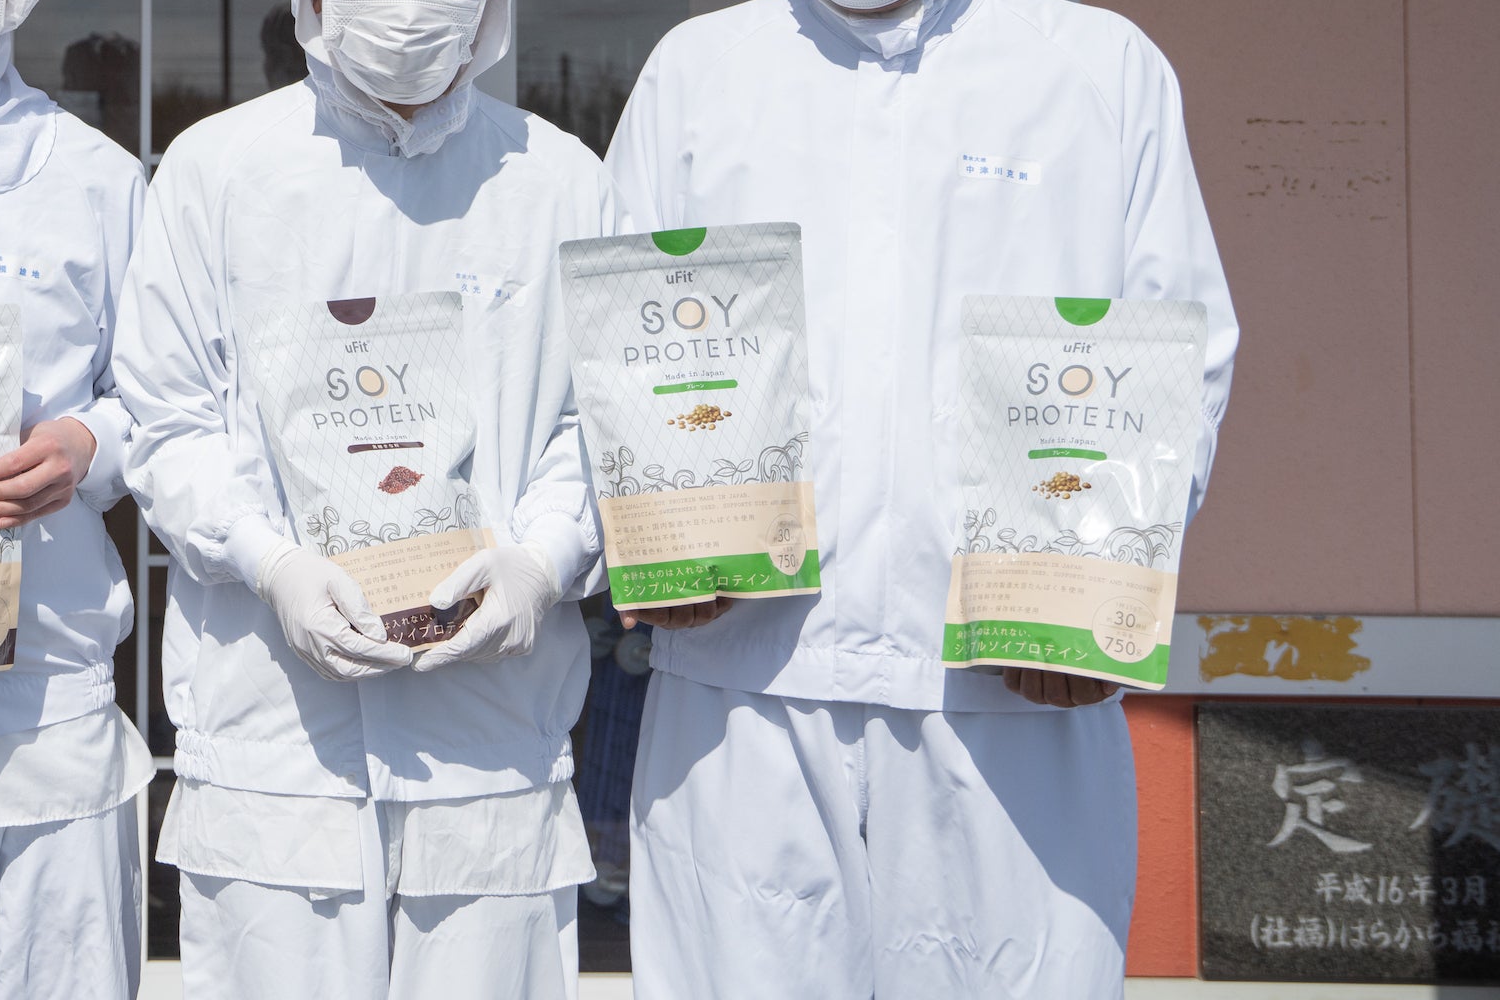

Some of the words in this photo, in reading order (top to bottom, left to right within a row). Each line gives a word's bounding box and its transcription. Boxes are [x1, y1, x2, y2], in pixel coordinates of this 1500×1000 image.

[666, 271, 693, 284] uFit
[641, 294, 739, 334] SOY
[345, 341, 368, 354] uFit
[623, 336, 761, 367] PROTEIN
[1063, 342, 1092, 354] uFit
[326, 363, 409, 401] SOY
[665, 373, 686, 381] Made
[701, 370, 725, 379] Japan
[1026, 363, 1133, 398] SOY
[312, 402, 437, 430] PROTEIN
[1008, 405, 1144, 433] PROTEIN
[777, 528, 790, 543] 30
[623, 573, 771, 597] シンプルソイプロテイン
[1114, 610, 1136, 628] 30
[955, 640, 1088, 661] シプルソイプロテイン
[1315, 872, 1486, 906] 平成16年3月
